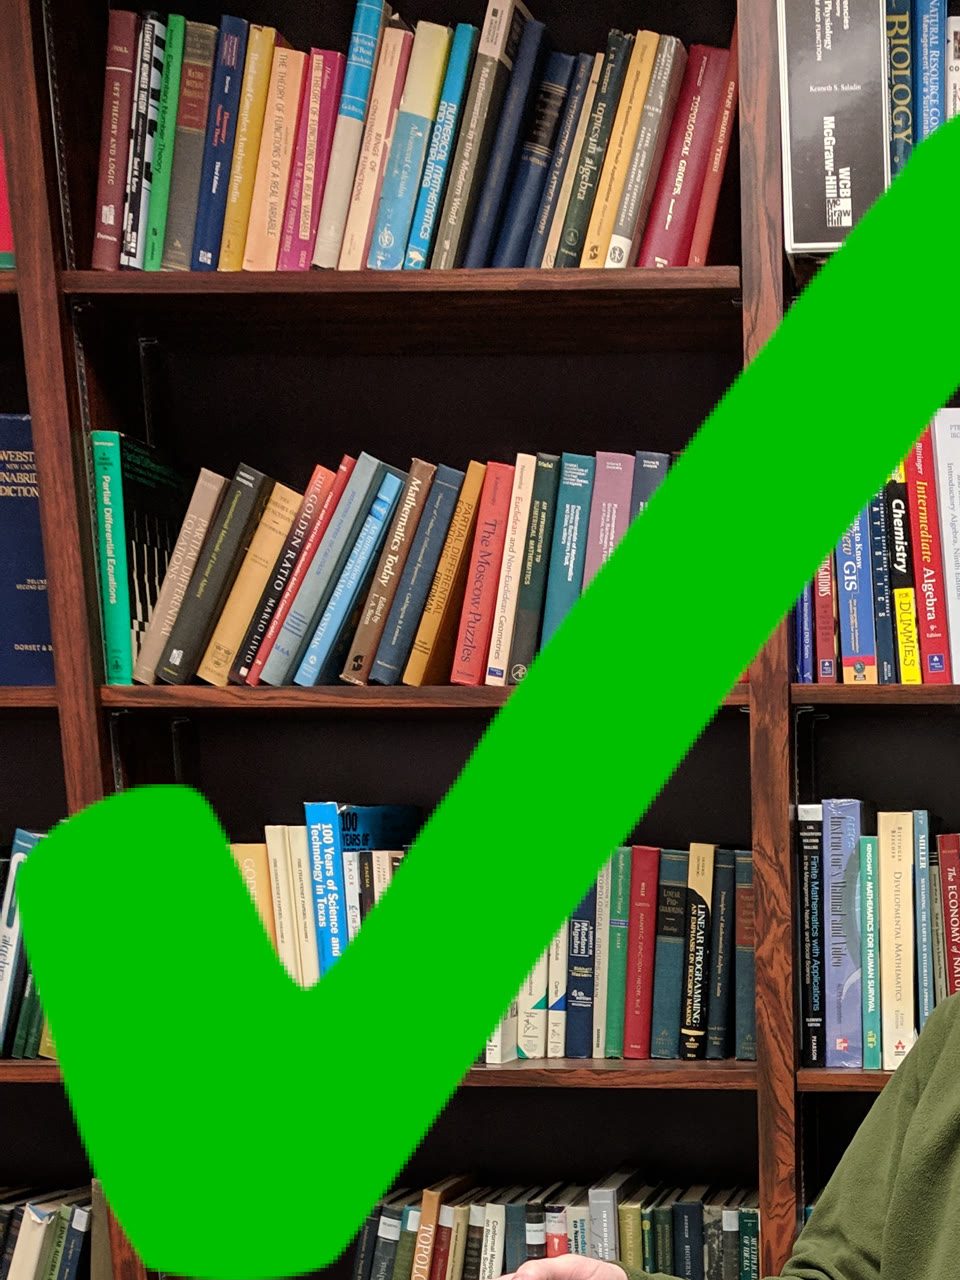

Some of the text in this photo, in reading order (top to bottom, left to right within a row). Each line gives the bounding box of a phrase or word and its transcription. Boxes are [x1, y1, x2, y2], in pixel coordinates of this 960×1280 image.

[470, 65, 489, 134] Mathematics
[886, 11, 913, 145] BIOLOGY
[684, 95, 701, 157] TOPOLOGICAL
[823, 116, 837, 198] McGraw-Hill
[448, 199, 463, 225] World
[454, 159, 471, 199] Modern
[577, 156, 598, 200] algebra
[838, 167, 851, 198] WCB
[102, 475, 117, 604] Partial Differential Equations
[393, 476, 422, 550] Mathematics
[891, 499, 908, 574] Chemistry
[915, 442, 938, 621] Bittinger Intermediate Algebra
[381, 549, 399, 588] Today
[460, 519, 497, 663] The Moscow Puzzles
[843, 561, 858, 592] GIS
[899, 600, 916, 667] DUMMIES
[310, 823, 327, 928] Technology in Texas
[918, 834, 928, 869] MILLER
[322, 823, 341, 957] 100 Years of Science and
[691, 904, 706, 1028] LINEAR PROGRAMMING:
[810, 855, 820, 1012] Finite Mathematics with Applications
[892, 871, 903, 1002] DEVELOPMENTAL MATHEMATICS
